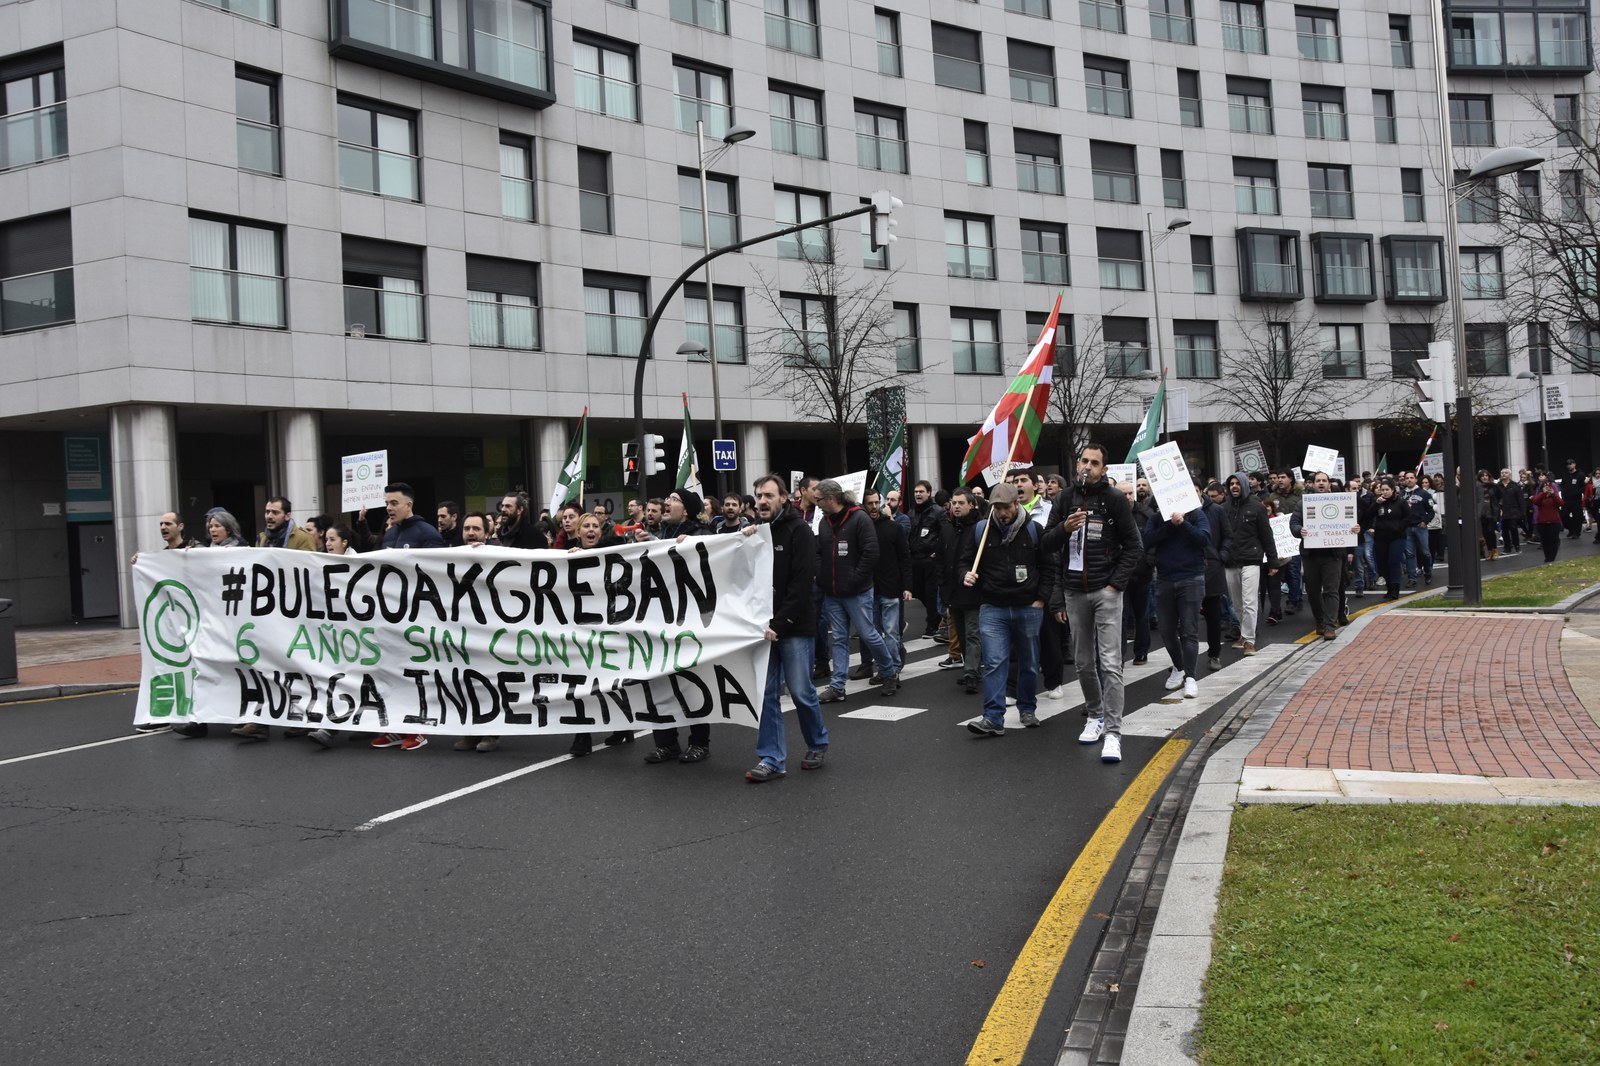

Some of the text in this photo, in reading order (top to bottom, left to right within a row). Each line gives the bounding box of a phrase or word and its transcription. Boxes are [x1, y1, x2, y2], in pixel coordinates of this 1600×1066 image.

[715, 450, 735, 460] TAXI
[189, 497, 198, 506] 7
[1323, 538, 1346, 546] ELLOS
[222, 541, 717, 628] #BULEGOAKGREBAN
[236, 622, 702, 672] 6 AÑOS SIN CONVENIO
[235, 664, 759, 727] HUELGA INDEFINIDA
